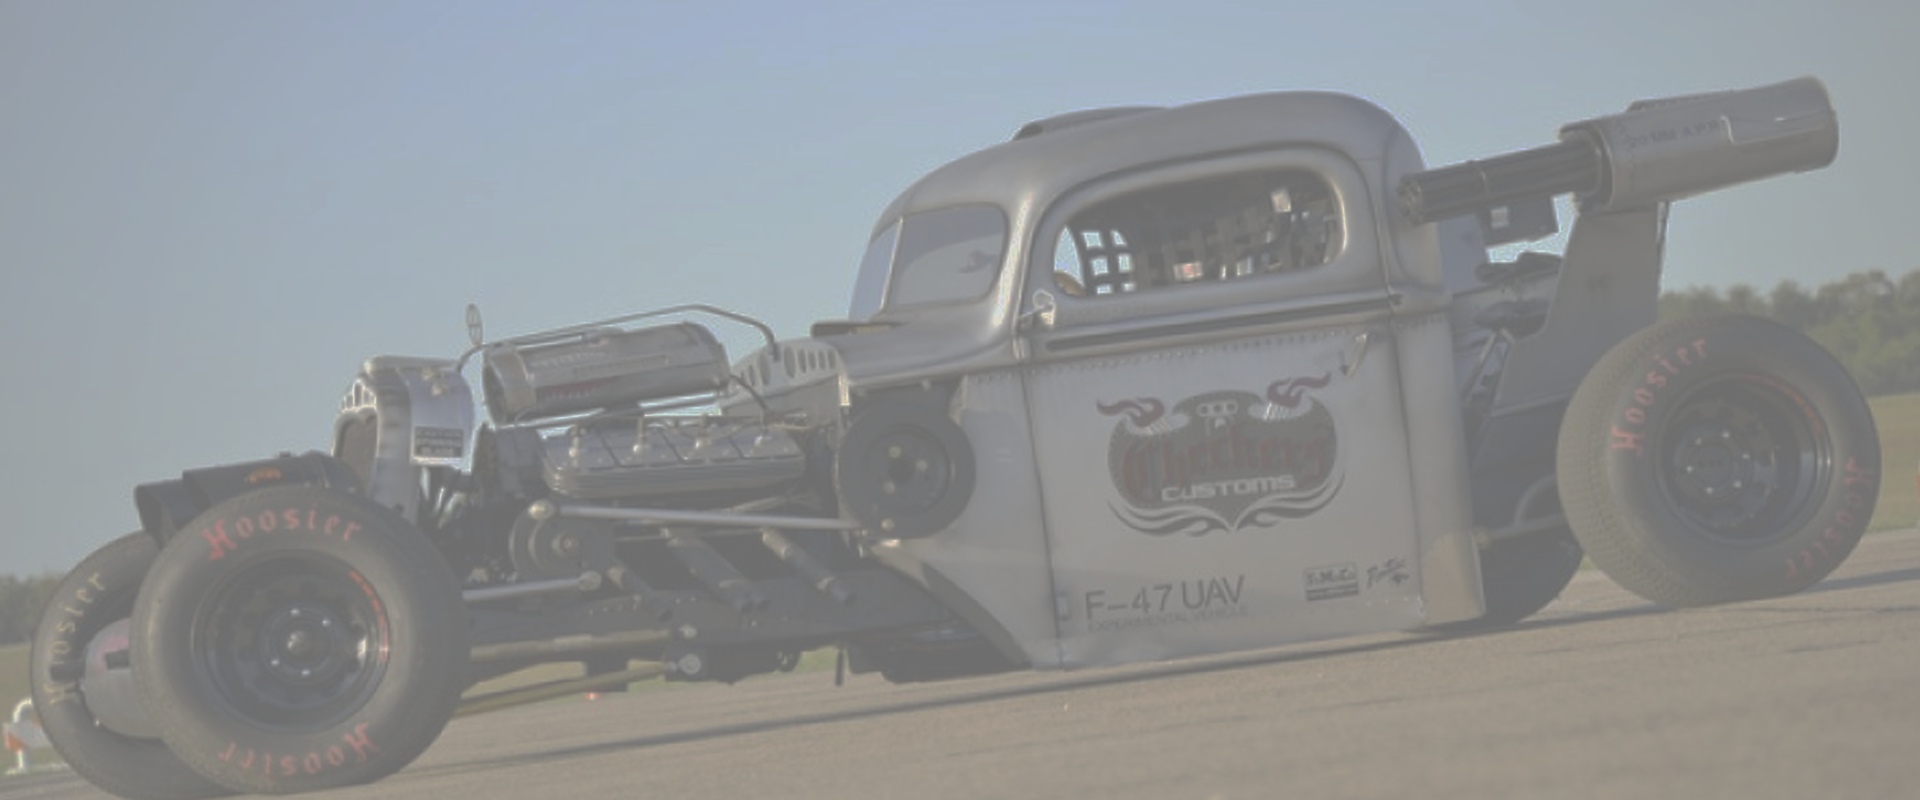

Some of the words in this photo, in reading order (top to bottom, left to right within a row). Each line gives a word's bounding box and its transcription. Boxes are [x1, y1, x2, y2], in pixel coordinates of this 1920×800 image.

[1611, 337, 1708, 459] Hoosier
[1161, 474, 1296, 501] CUSTOMS
[1786, 453, 1872, 576] Hoosier
[201, 501, 361, 560] Hoosier
[1085, 584, 1173, 619] F-47
[1181, 574, 1246, 610] UAV
[43, 572, 105, 704] Hosier
[216, 722, 379, 777] Hoosier
